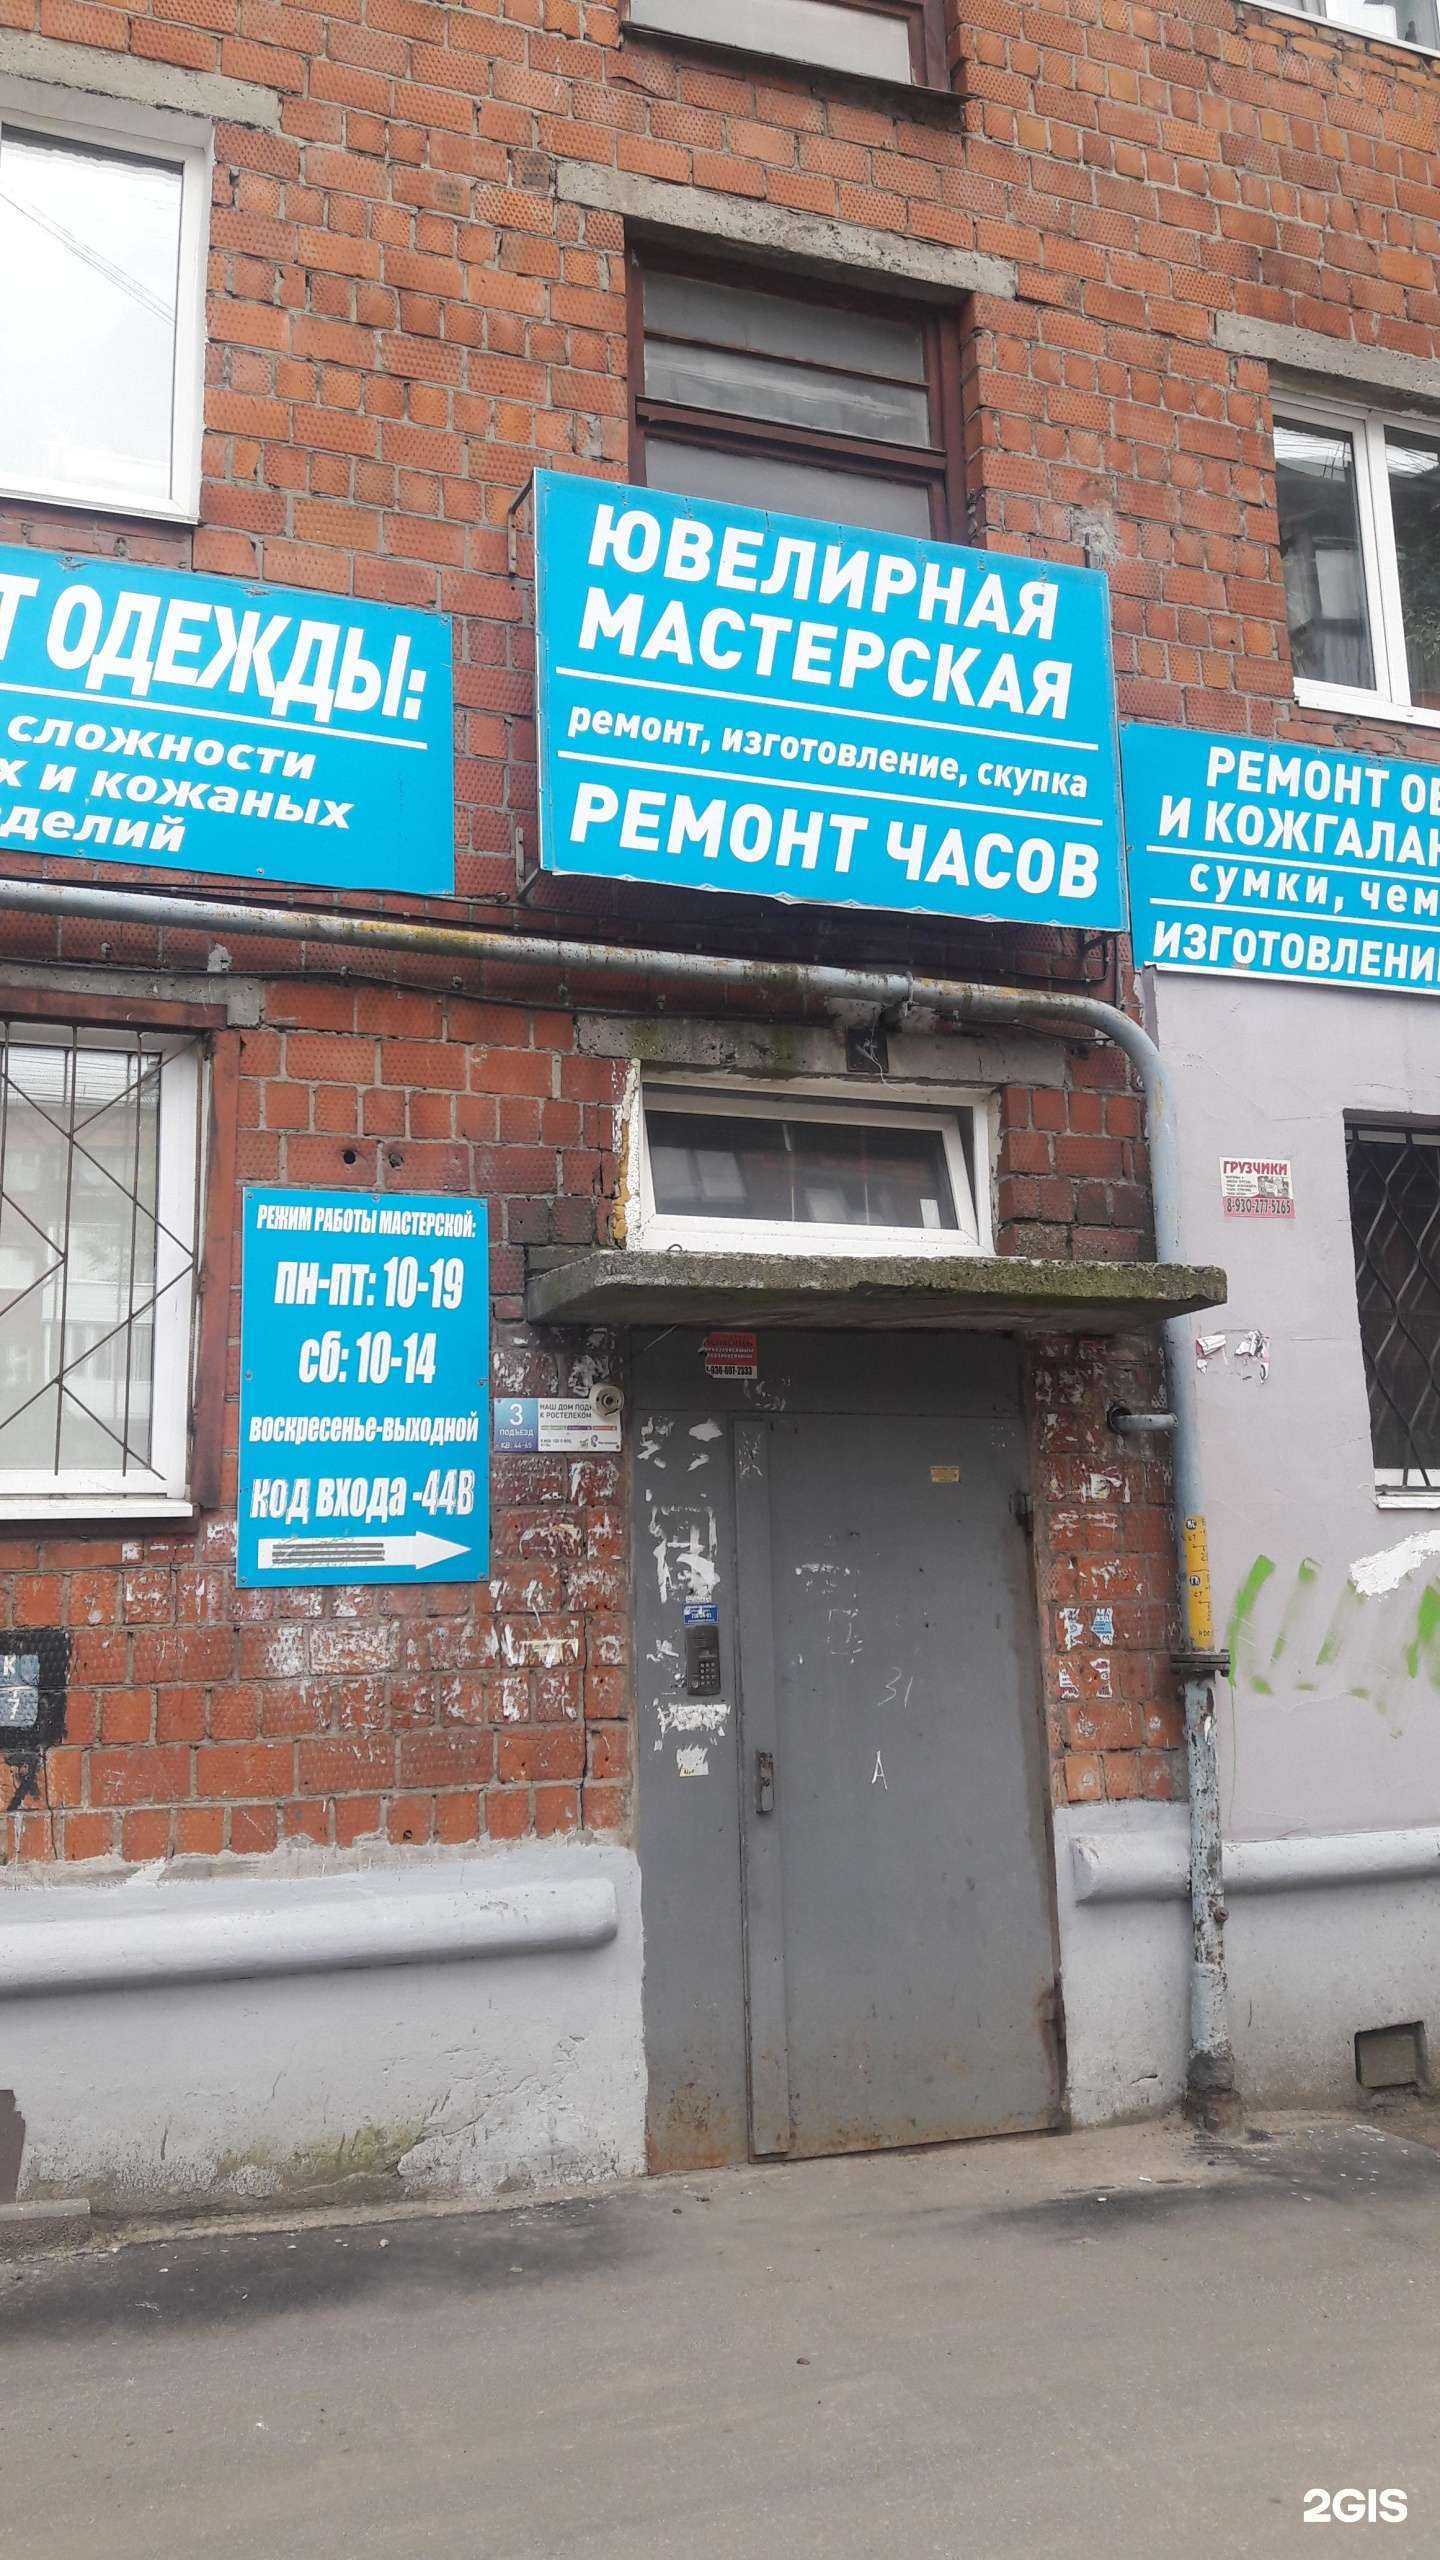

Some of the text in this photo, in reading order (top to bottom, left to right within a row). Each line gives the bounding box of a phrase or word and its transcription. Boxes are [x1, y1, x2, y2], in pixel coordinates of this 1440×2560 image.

[588, 503, 1059, 640] ЮВЕЛИРНАЯ
[46, 584, 427, 723] ОДЕЖДЫ:
[578, 587, 1072, 720] МАСТЕРСКАЯ
[7, 714, 316, 780] сложности
[567, 705, 1089, 798] ремонт, изготовление, скупка
[1206, 746, 1390, 808] РЕМОНТ
[40, 764, 76, 793] и
[91, 770, 354, 829] кожаных
[1158, 795, 1192, 838] И
[0, 805, 186, 853] делий
[569, 782, 1100, 899] РЕМОНТ ЧАСОВ
[1189, 863, 1344, 913] сумки,
[1153, 920, 1440, 982] ИЗГОТОВЛЕНИ
[1223, 1160, 1288, 1175] ГРУЗЧИКИ
[256, 1204, 477, 1238] РЕЖИМ РАБОТЫ МАСТЕРСКОЙ:
[384, 1256, 464, 1309] 10-19
[356, 1331, 437, 1384] 10-14
[510, 1403, 523, 1425] 3
